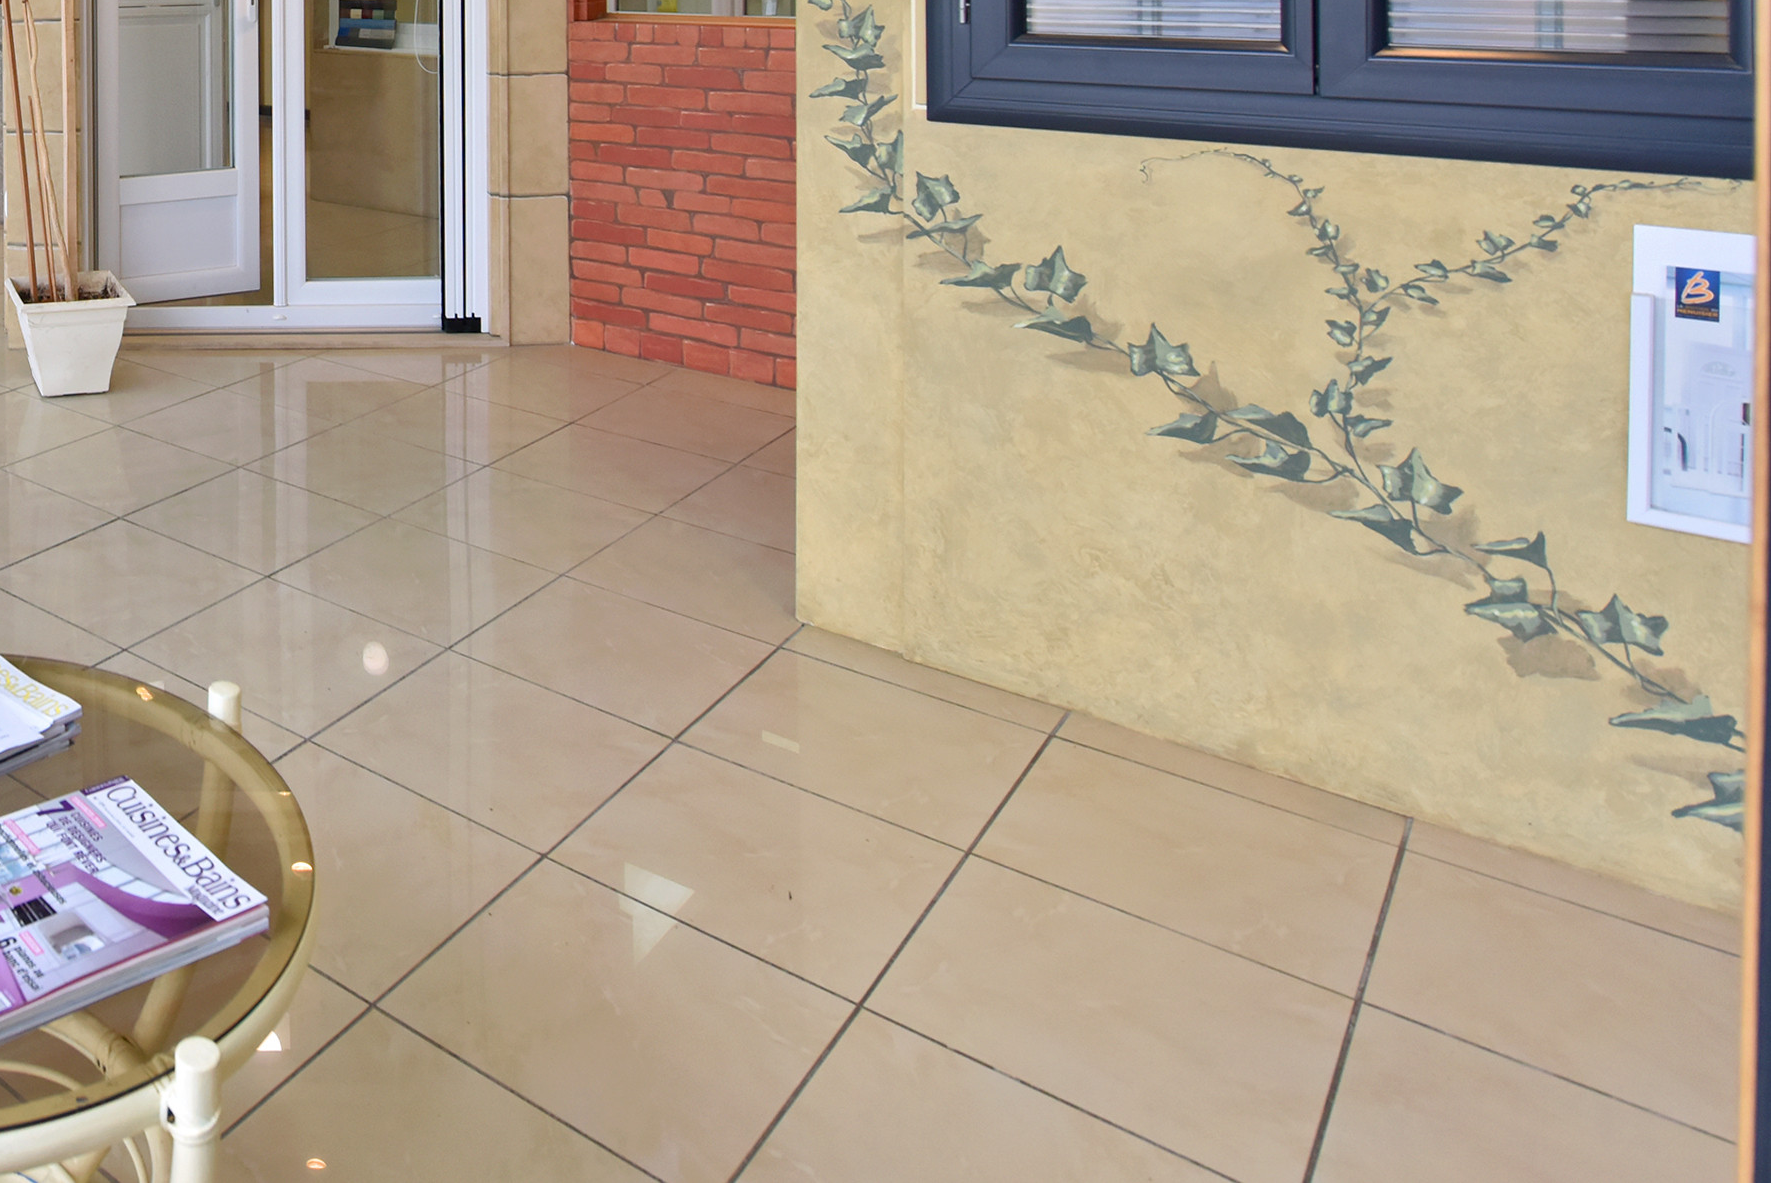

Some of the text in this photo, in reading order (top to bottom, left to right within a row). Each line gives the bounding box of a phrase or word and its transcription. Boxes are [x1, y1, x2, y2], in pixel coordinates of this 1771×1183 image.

[1681, 271, 1715, 305] B
[36, 800, 75, 816] 7
[71, 812, 104, 842] CUISINES
[59, 816, 72, 826] DE
[68, 826, 107, 863] DESIGNERS
